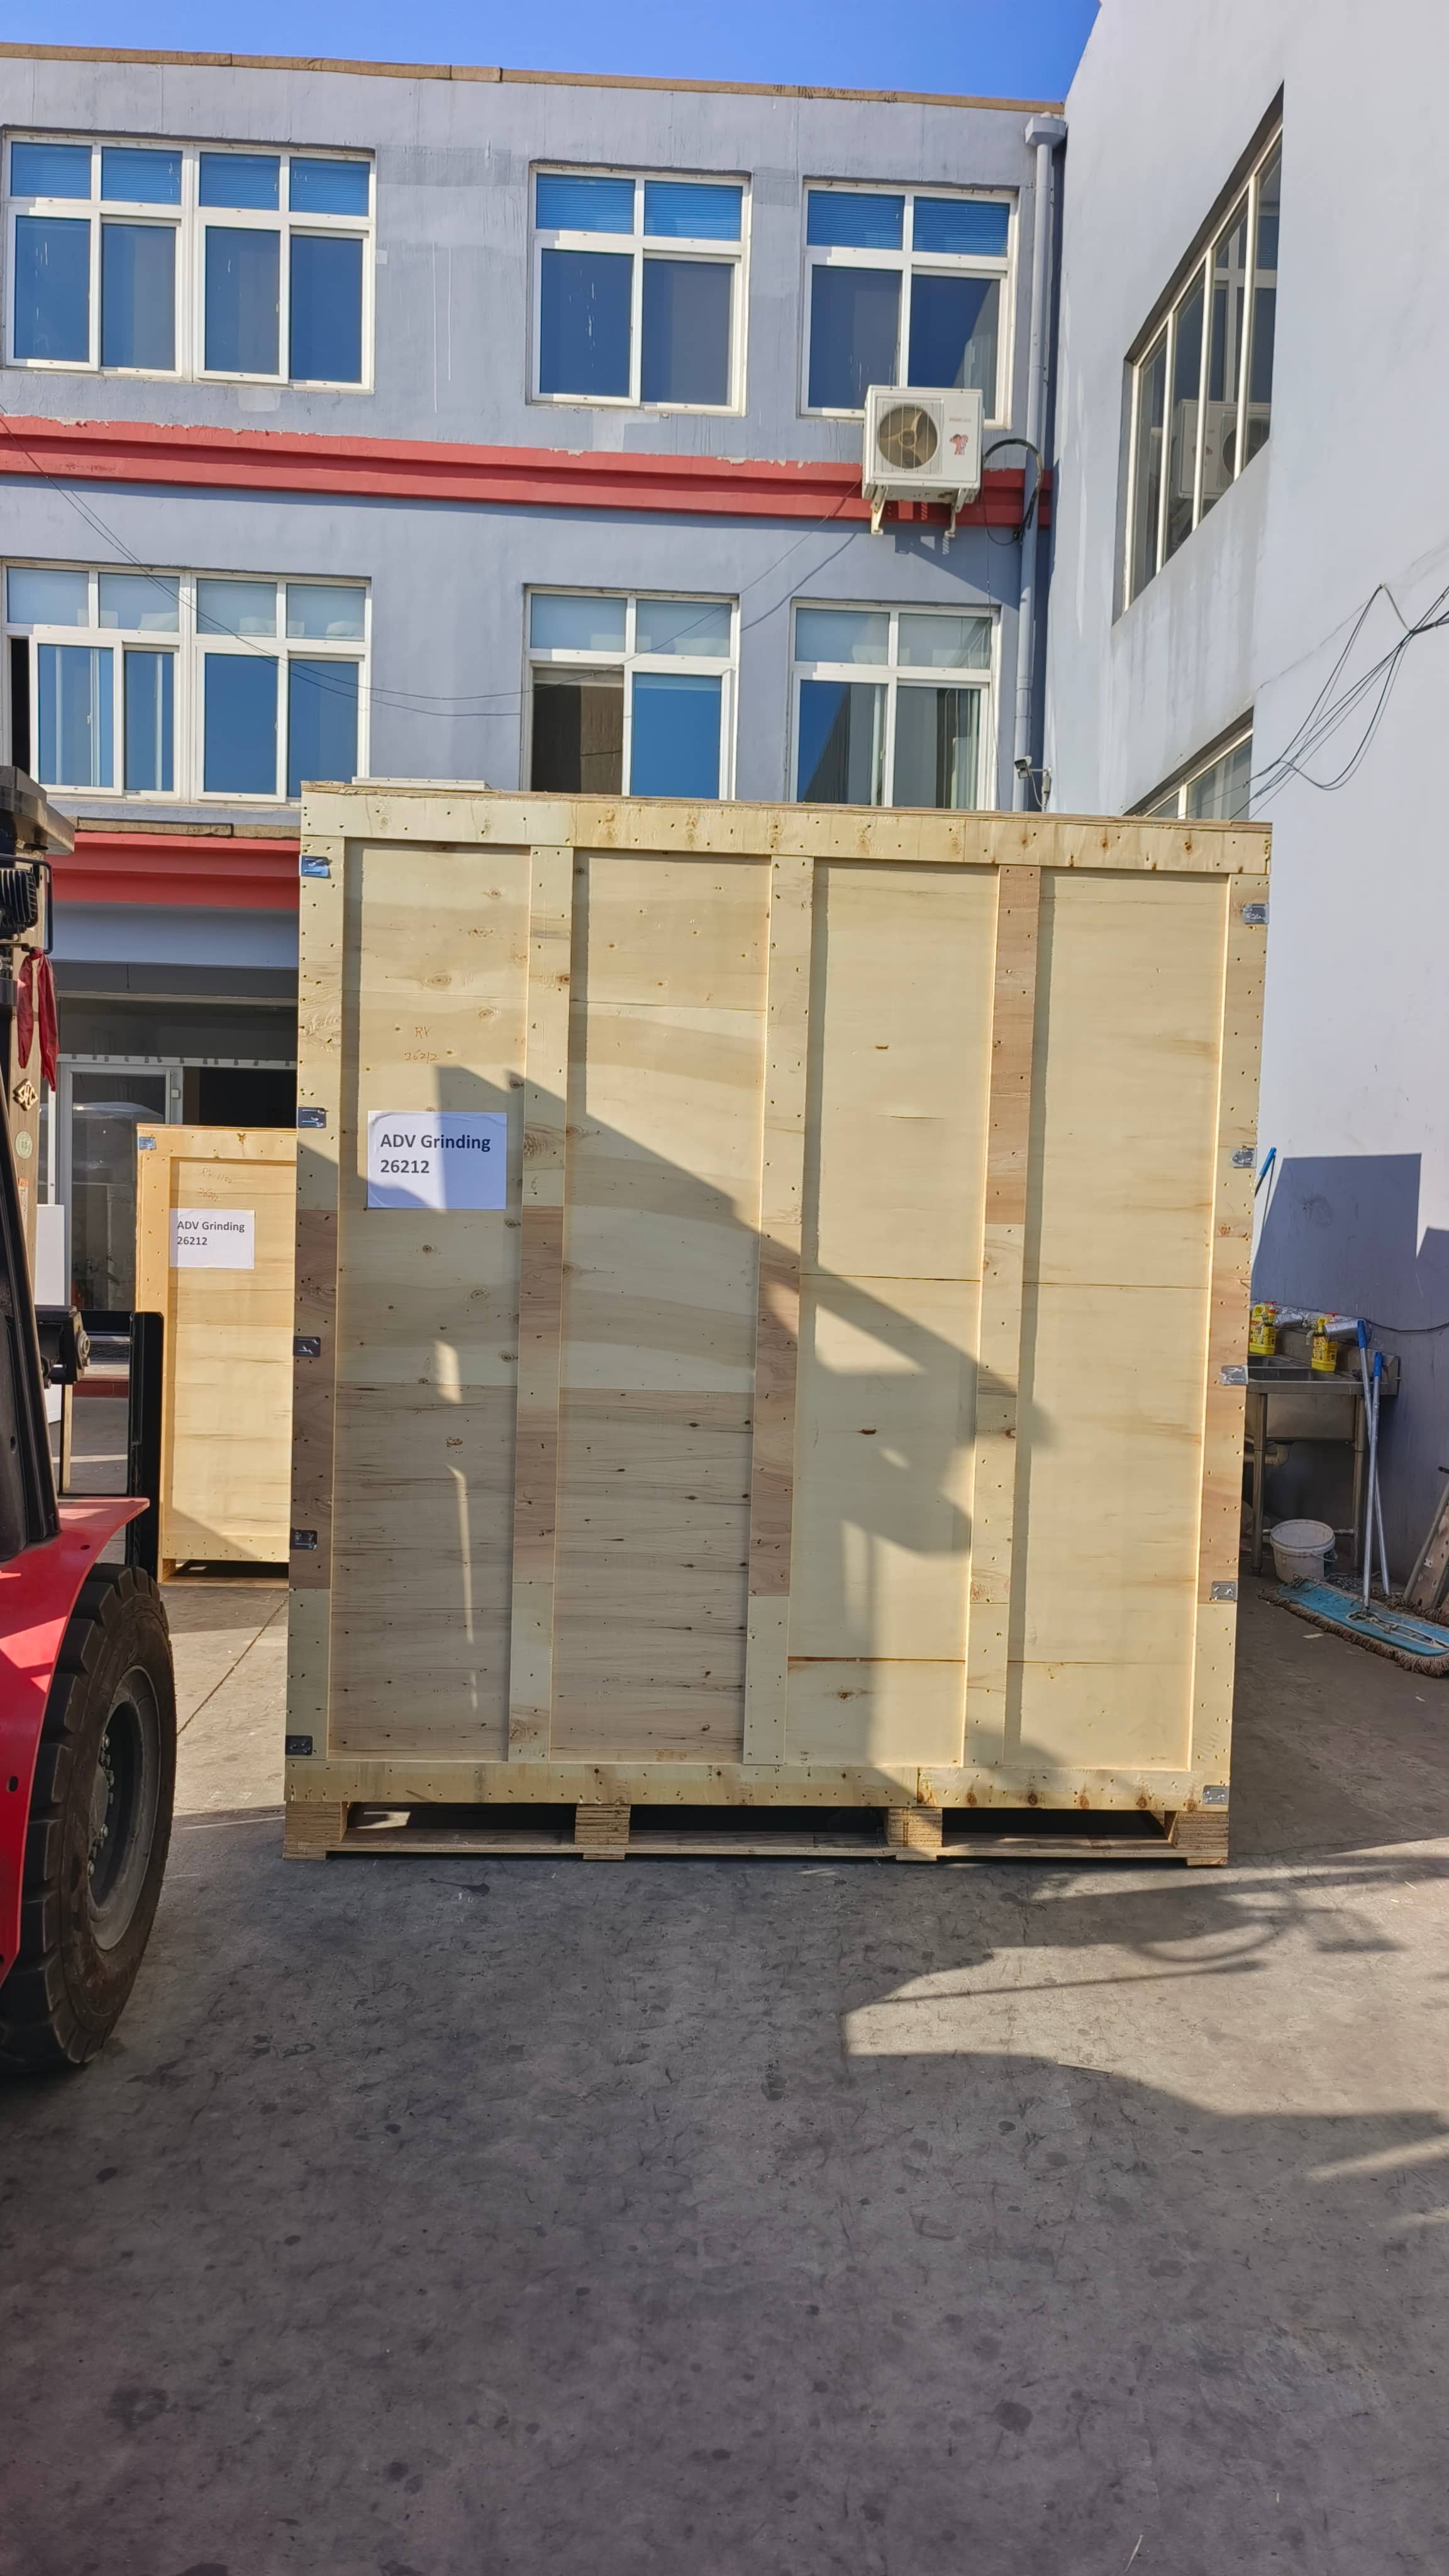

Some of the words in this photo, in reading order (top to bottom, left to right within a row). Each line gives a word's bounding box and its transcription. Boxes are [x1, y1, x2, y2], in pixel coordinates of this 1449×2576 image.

[380, 1134, 416, 1148] ADV
[421, 1135, 491, 1152] Grinding
[380, 1160, 430, 1174] 26212
[177, 1221, 199, 1230] ADV
[202, 1221, 245, 1233] Grinding
[177, 1236, 208, 1245] 26212
